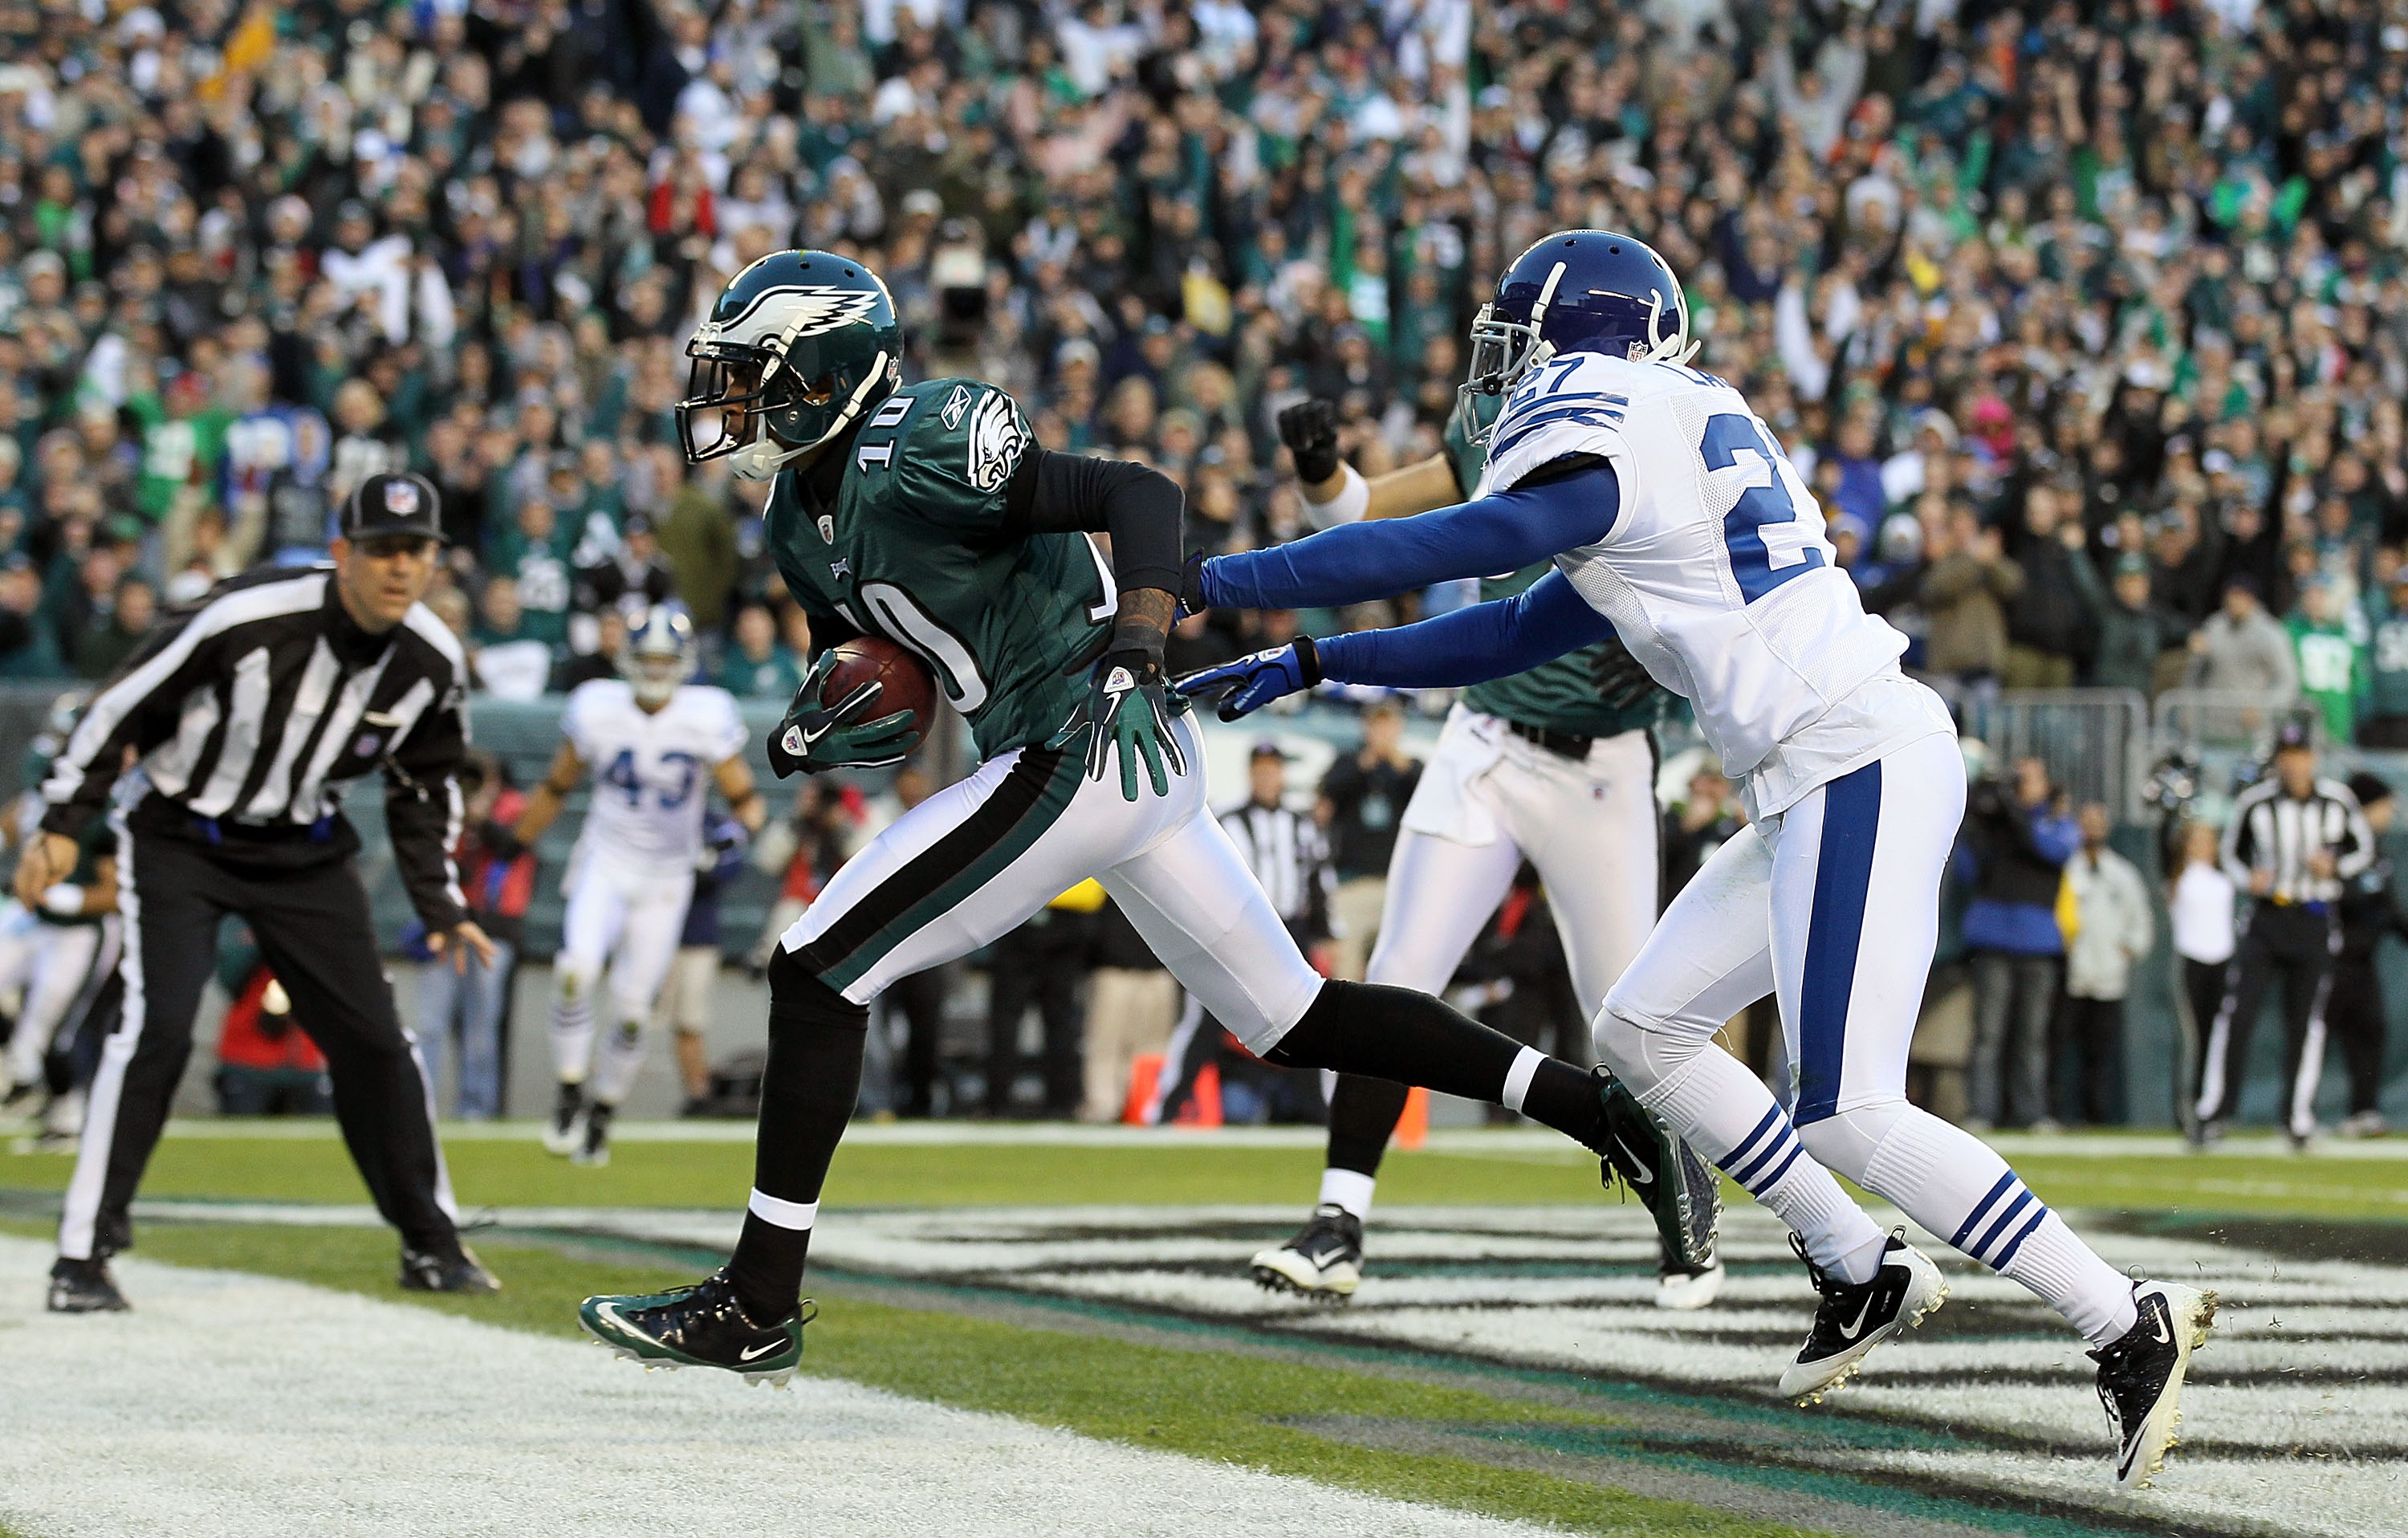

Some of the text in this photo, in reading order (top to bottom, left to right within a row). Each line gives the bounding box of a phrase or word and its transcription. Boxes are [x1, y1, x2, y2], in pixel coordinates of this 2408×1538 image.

[1509, 356, 1586, 411] 27
[856, 396, 916, 474] 10
[1699, 413, 1827, 606] 2
[834, 582, 988, 713] 0
[604, 747, 700, 812] 43
